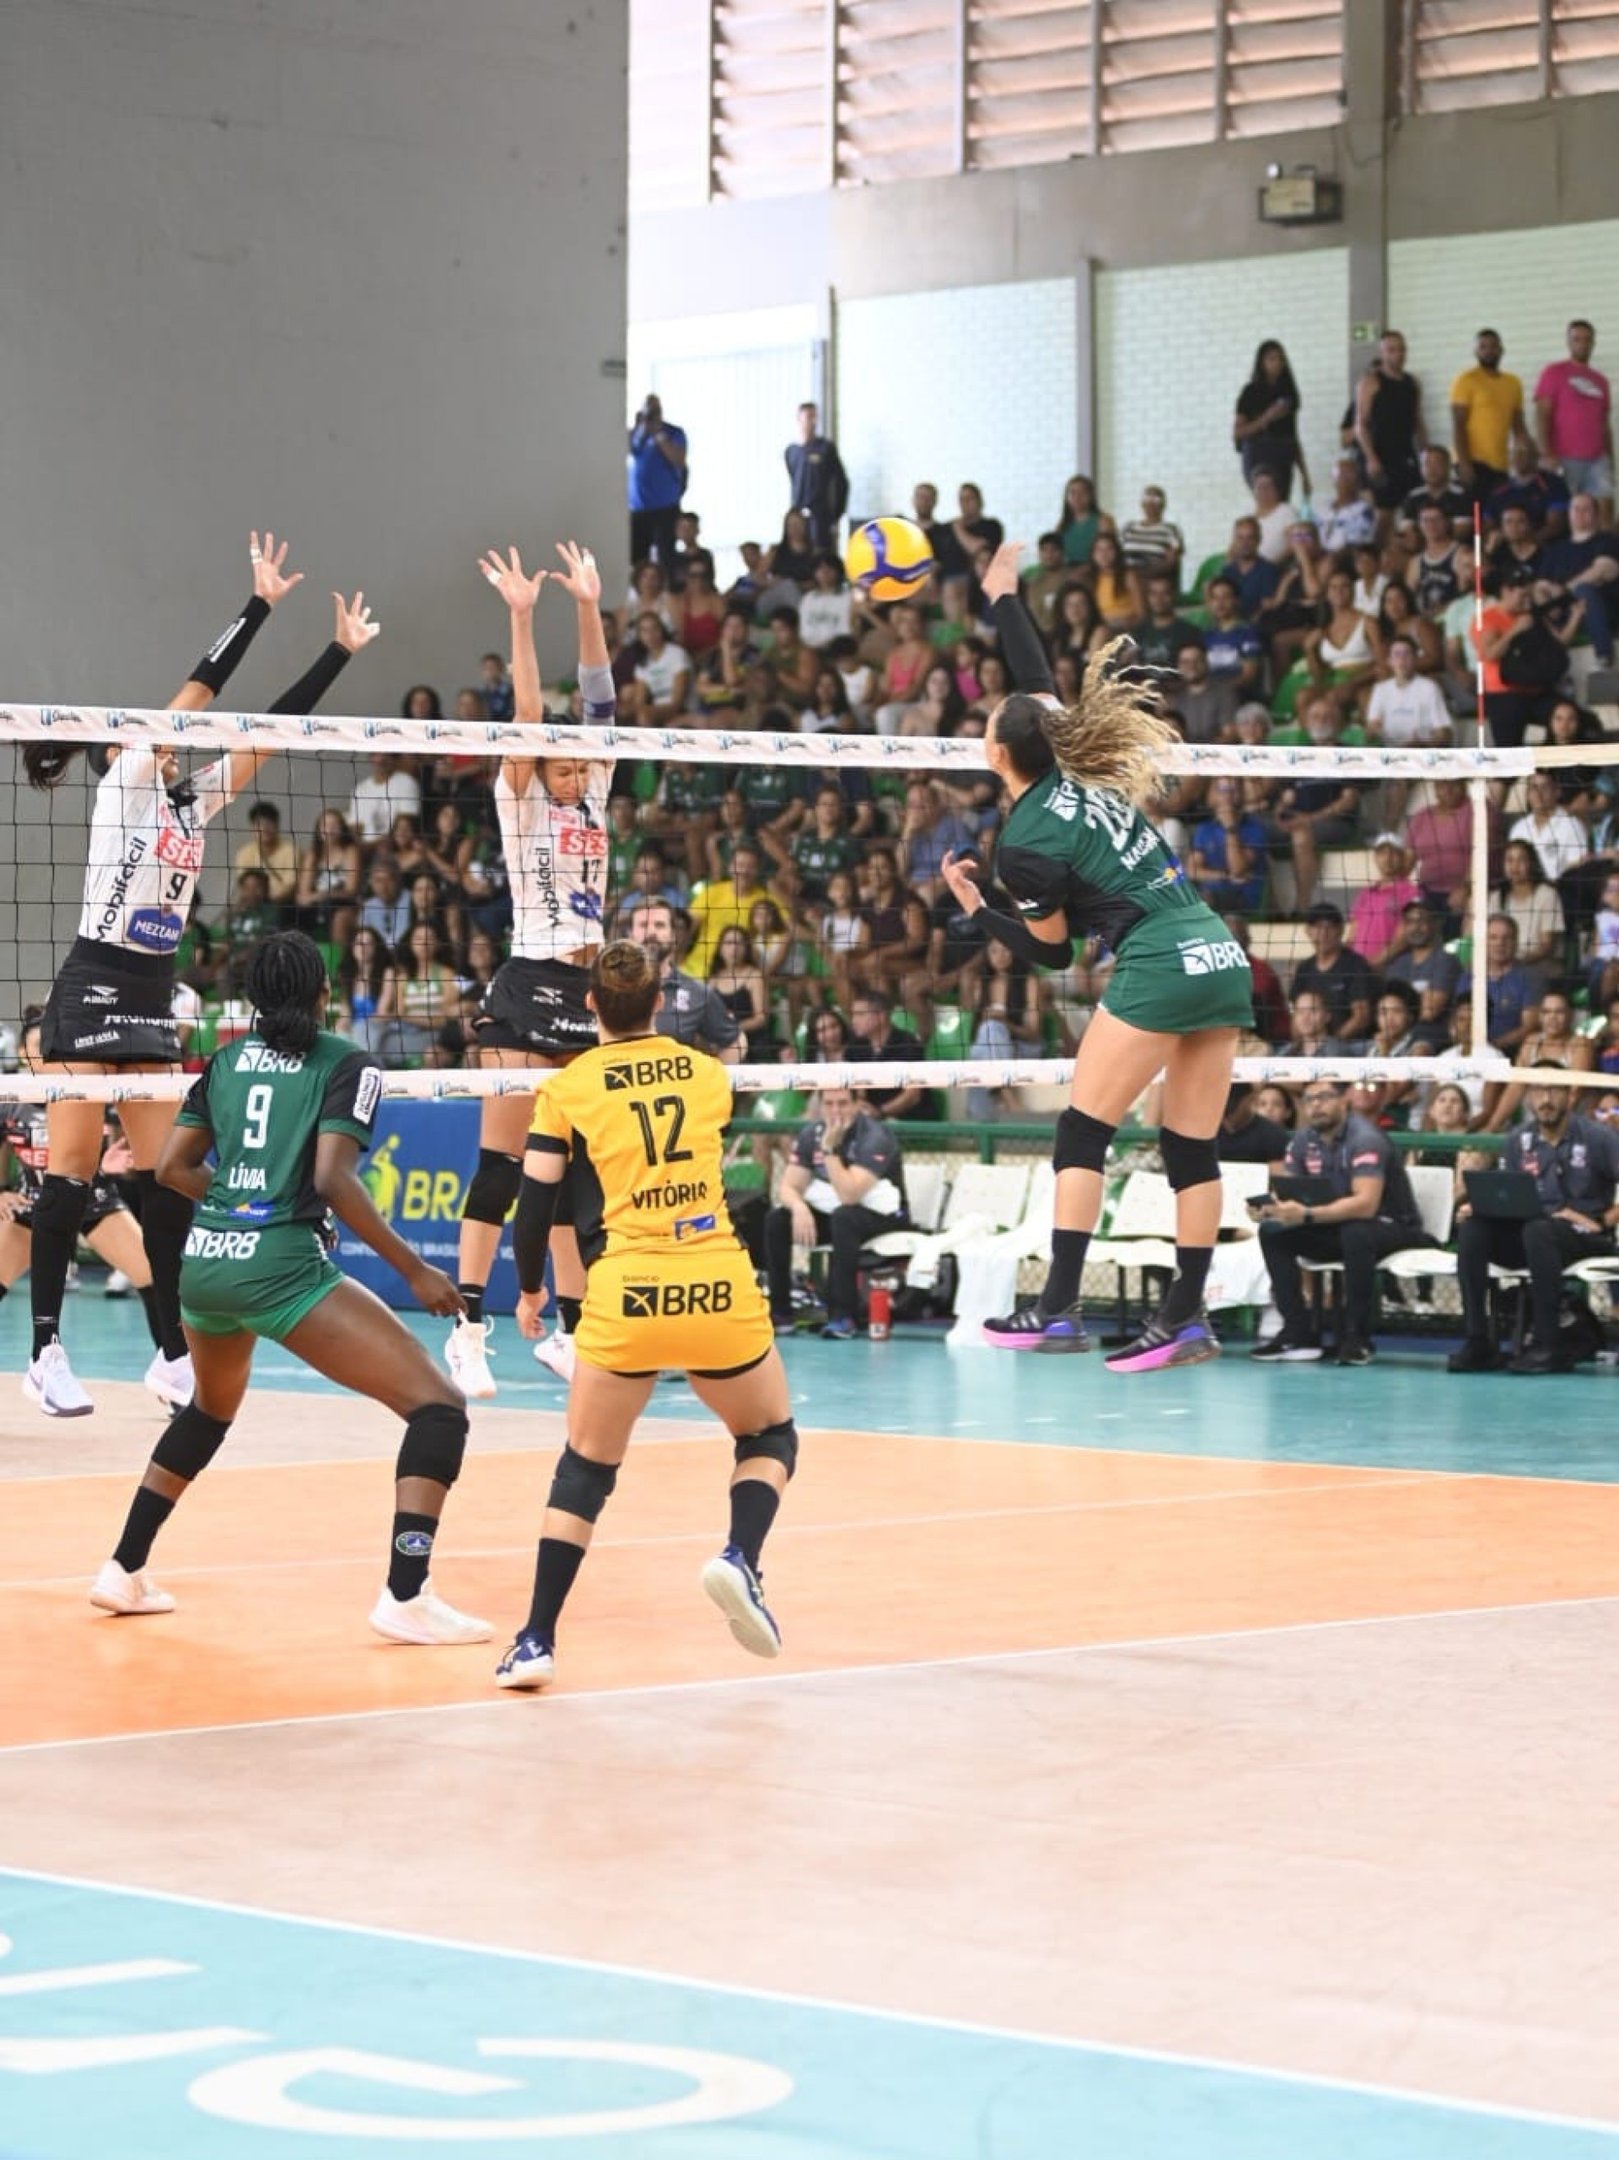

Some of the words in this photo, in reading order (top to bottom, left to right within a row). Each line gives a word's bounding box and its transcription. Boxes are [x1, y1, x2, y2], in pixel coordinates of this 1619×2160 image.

[636, 1056, 693, 1086] BRB
[242, 1084, 273, 1148] 9
[629, 1095, 693, 1168] 12
[201, 1231, 261, 1260] BRB
[662, 1280, 732, 1316] BRB
